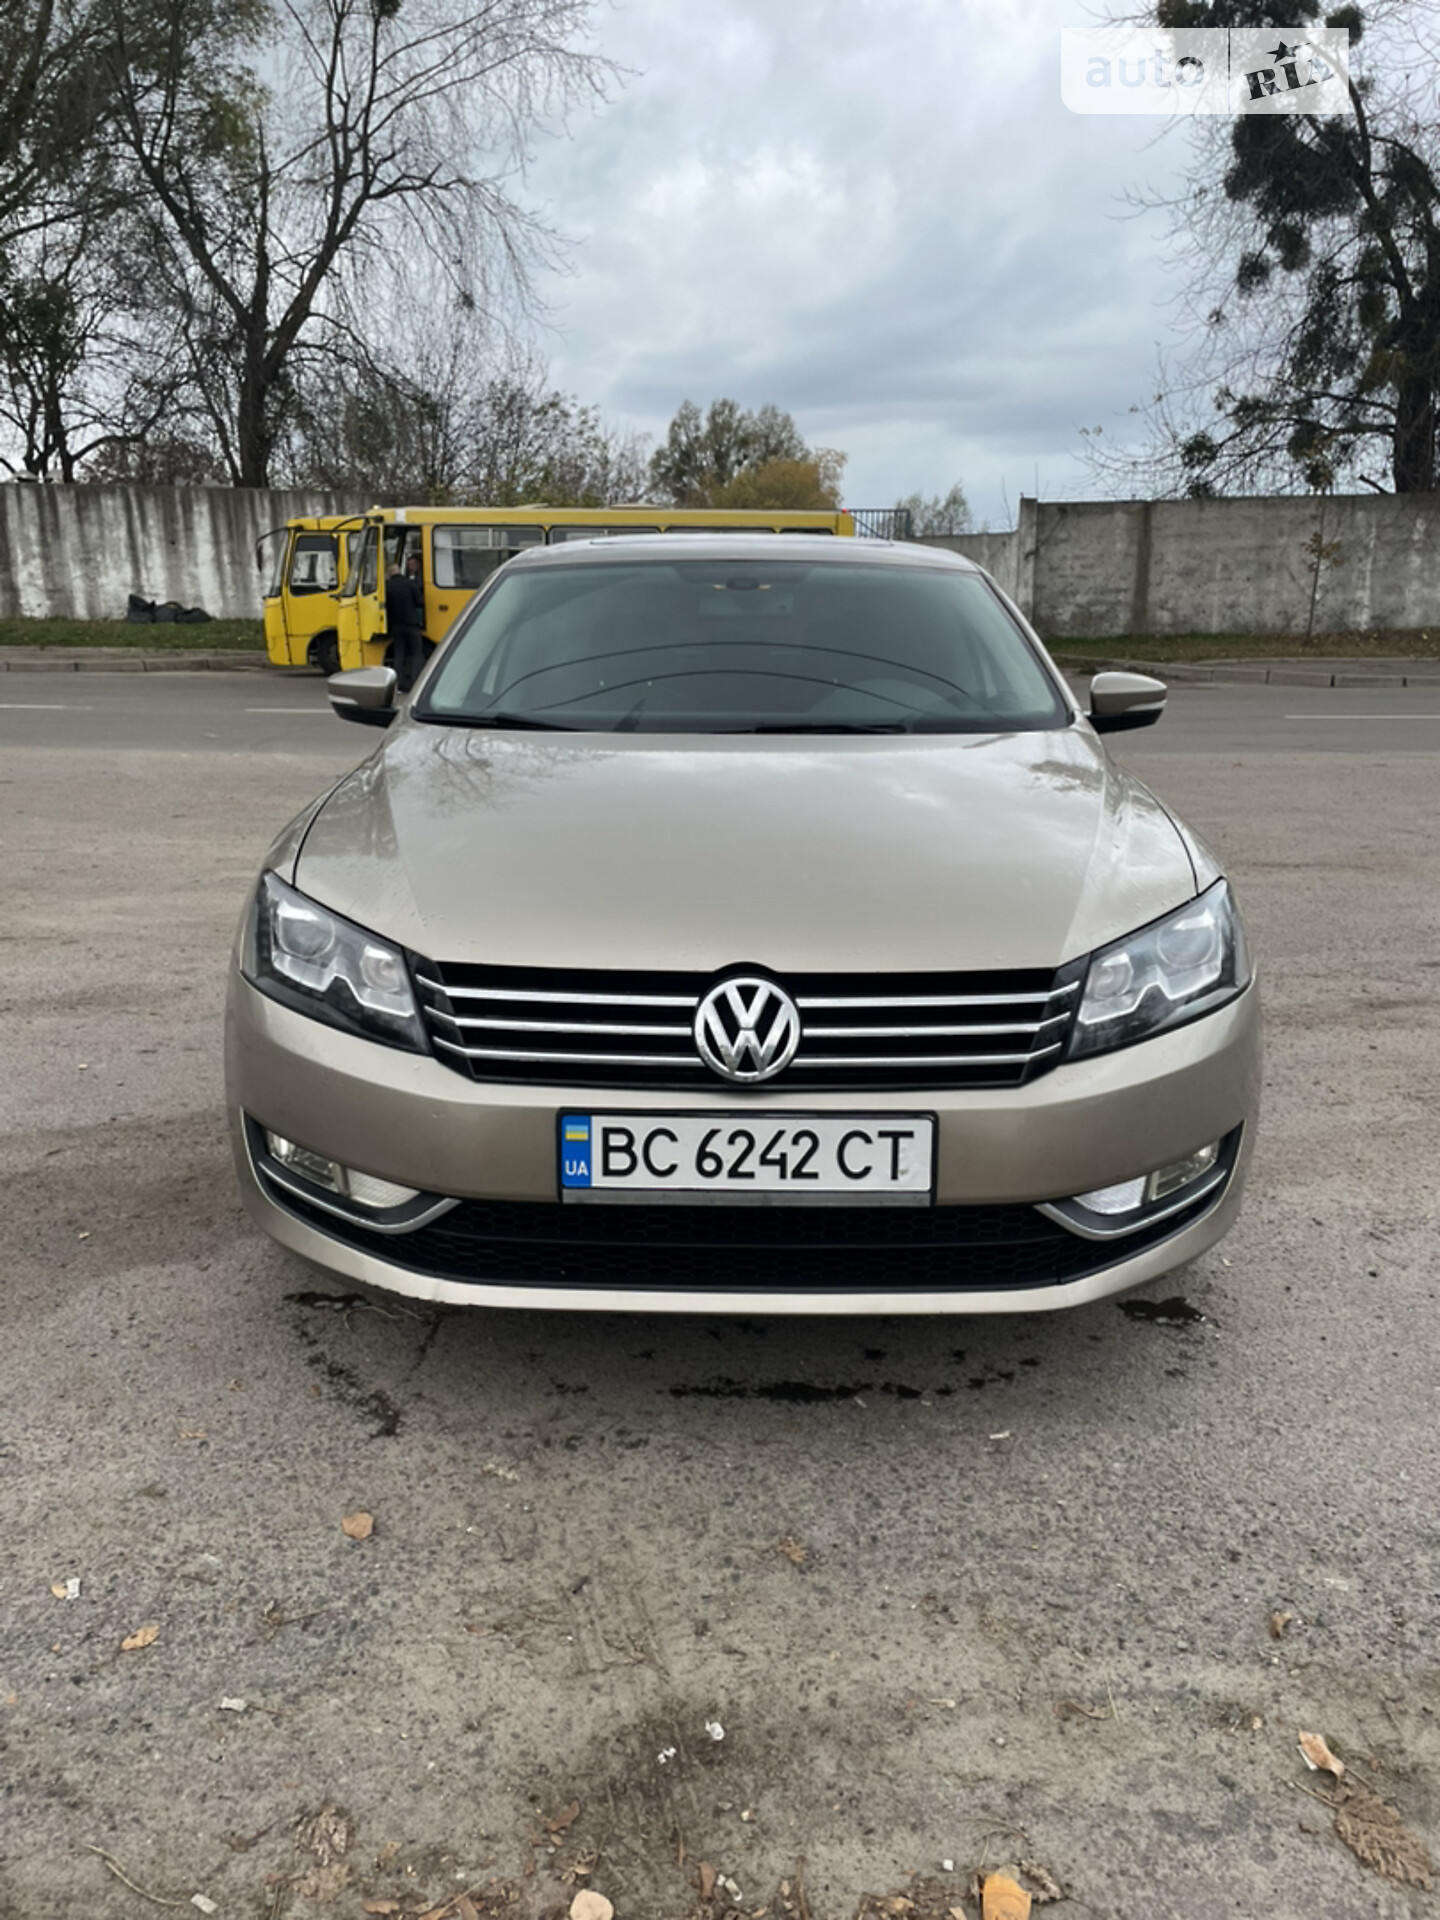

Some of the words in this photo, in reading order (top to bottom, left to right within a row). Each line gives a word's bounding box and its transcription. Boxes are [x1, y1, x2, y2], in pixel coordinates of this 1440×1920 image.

[565, 1161, 589, 1176] UA
[601, 1127, 679, 1178] BC
[695, 1128, 820, 1180] 6242
[836, 1130, 915, 1181] CT
